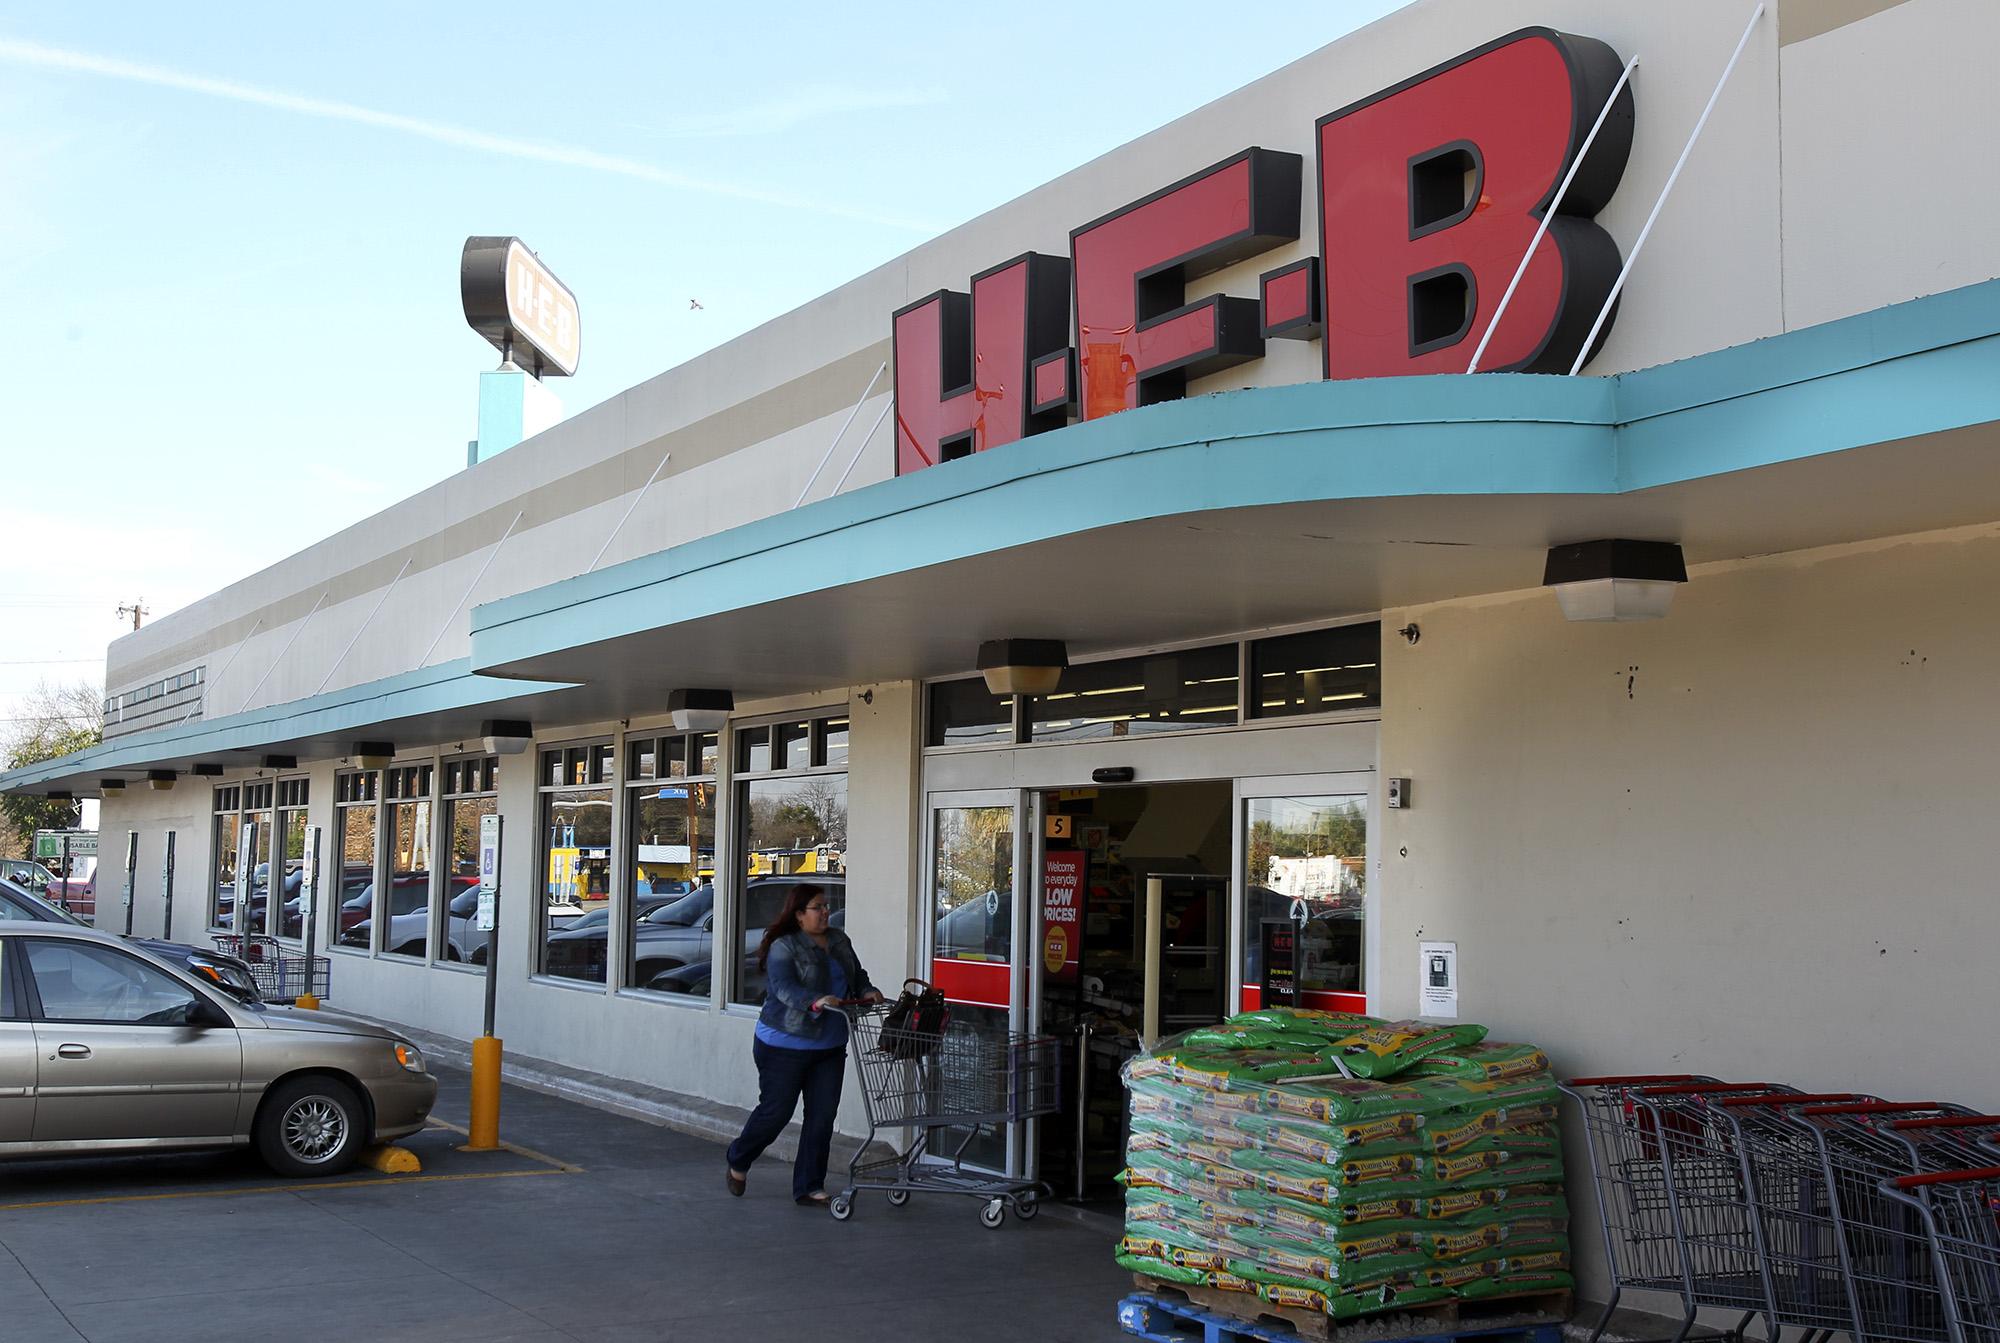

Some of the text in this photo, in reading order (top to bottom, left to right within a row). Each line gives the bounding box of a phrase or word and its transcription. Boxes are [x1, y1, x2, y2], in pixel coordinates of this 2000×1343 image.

[1055, 818, 1063, 834] 5
[1047, 861, 1075, 873] Welcome
[1050, 874, 1078, 887] everyday
[1046, 888, 1073, 905] LOW
